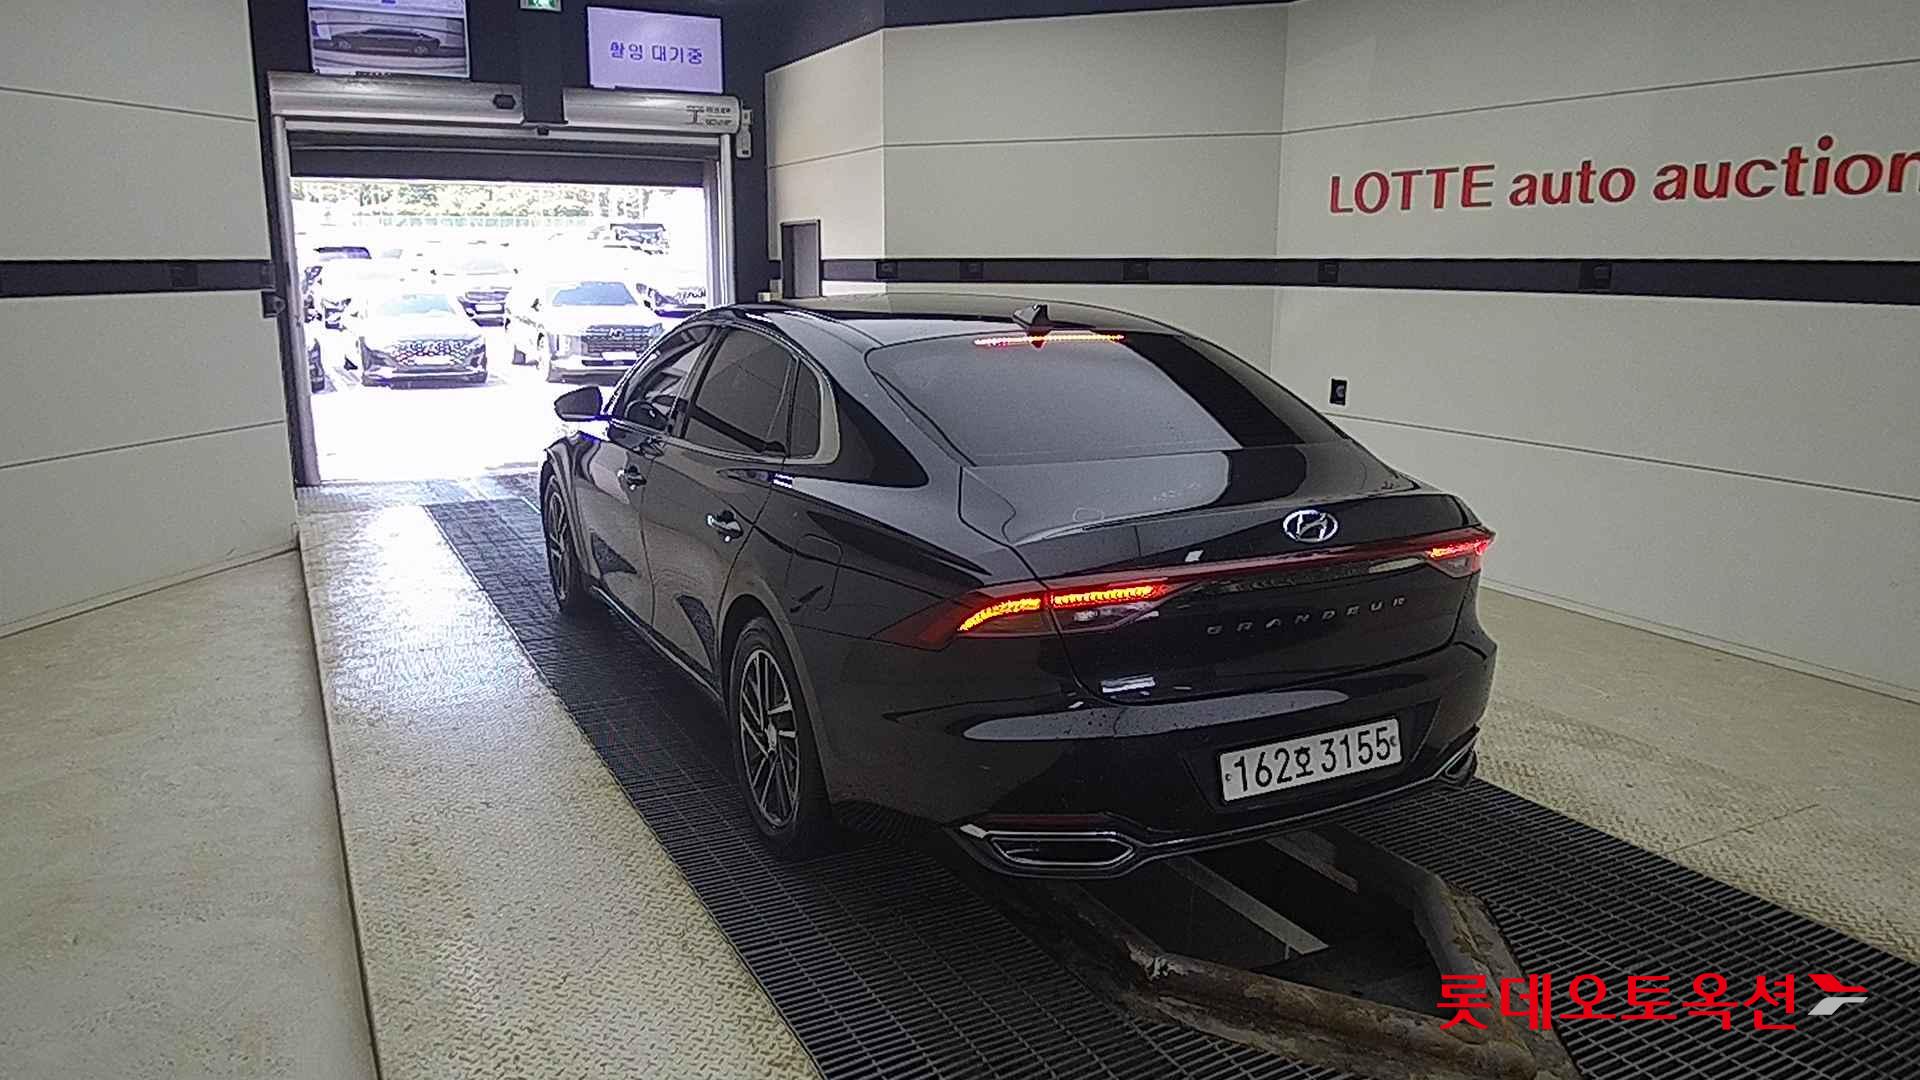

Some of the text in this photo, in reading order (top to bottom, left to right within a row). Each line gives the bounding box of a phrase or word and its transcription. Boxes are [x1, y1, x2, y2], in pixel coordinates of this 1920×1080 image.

[652, 44, 702, 65] 대기중
[1330, 164, 1495, 214] LOTTE
[1510, 160, 1635, 206] auto
[1206, 597, 1405, 634] GRANDEUR
[1319, 726, 1391, 773] 3155
